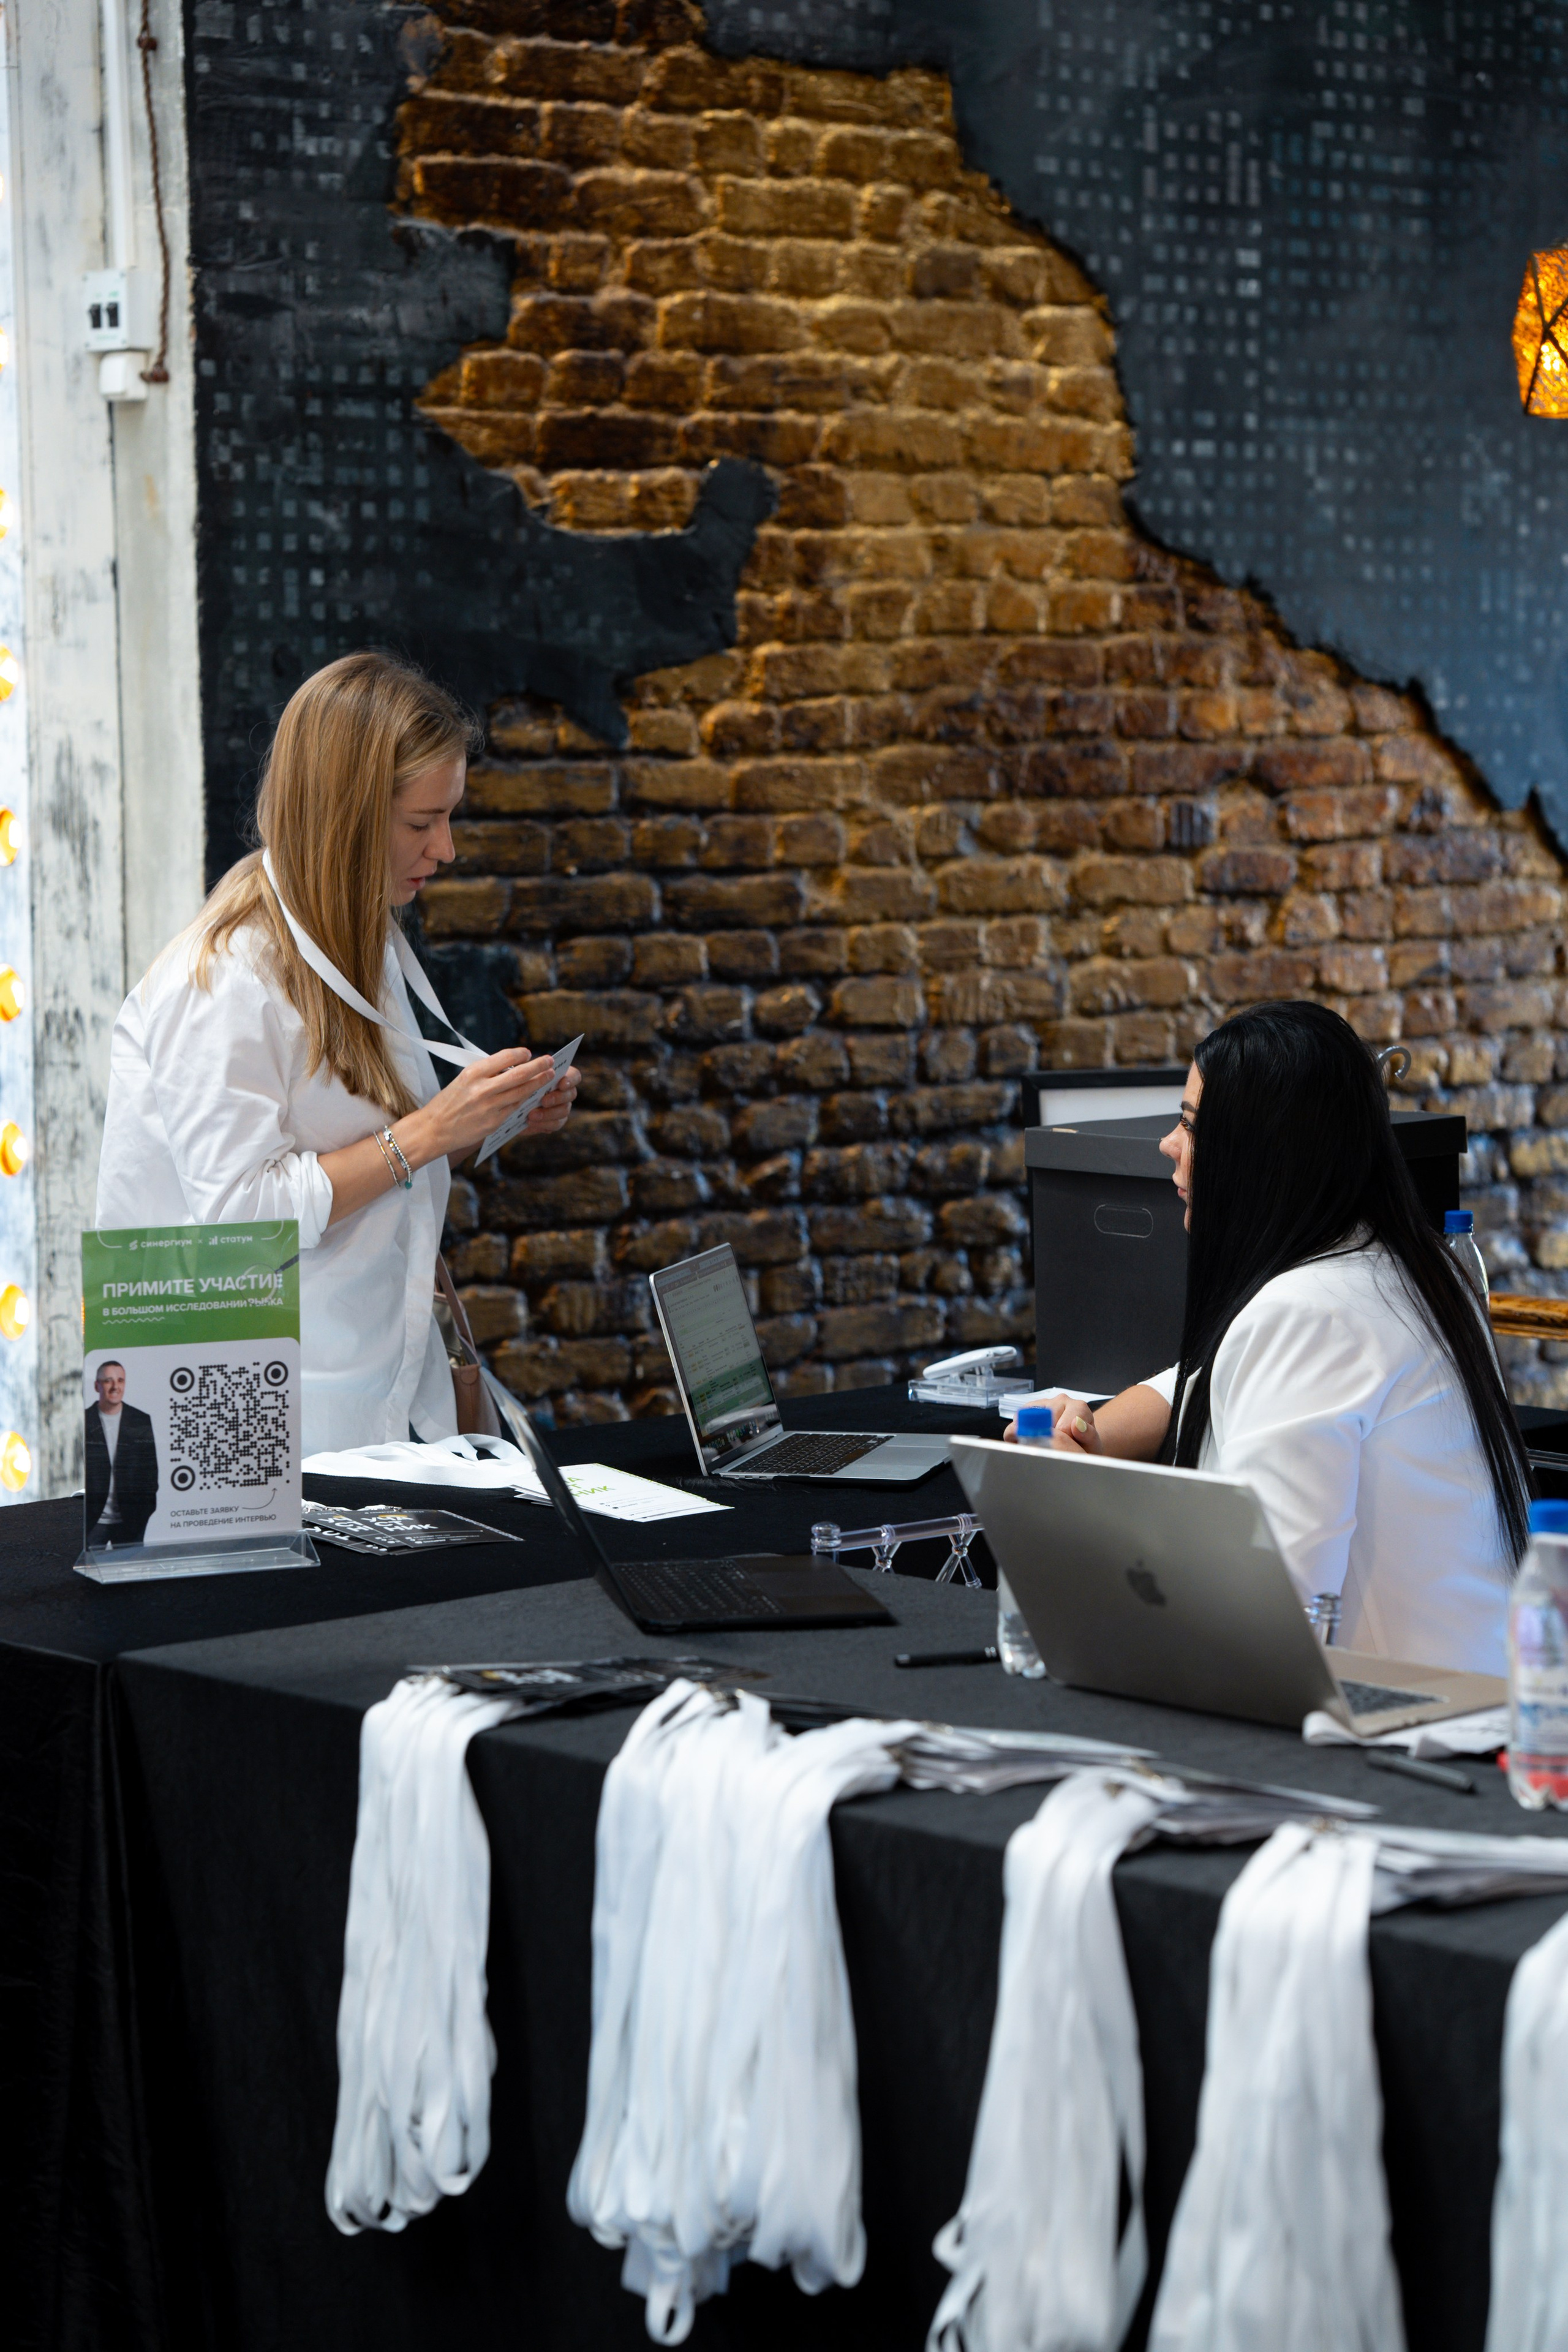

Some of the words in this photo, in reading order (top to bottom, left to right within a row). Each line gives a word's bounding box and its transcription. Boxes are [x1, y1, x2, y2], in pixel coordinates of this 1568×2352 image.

[140, 1238, 192, 1248] синергиум
[221, 1235, 253, 1245] статум
[103, 1279, 194, 1298] ПРИМИТЕ
[198, 1273, 283, 1292] УЧАСТИЕ
[103, 1308, 108, 1316] В
[111, 1304, 164, 1316] БОЛЬШОМ
[165, 1300, 247, 1312] ИССЛЕДОВАНИИ
[170, 1509, 208, 1517] ОСТАВЬТЕ
[183, 1517, 233, 1527] ПРОВЕДЕНИЕ
[235, 1514, 277, 1523] ИНТЕРВЬЮ
